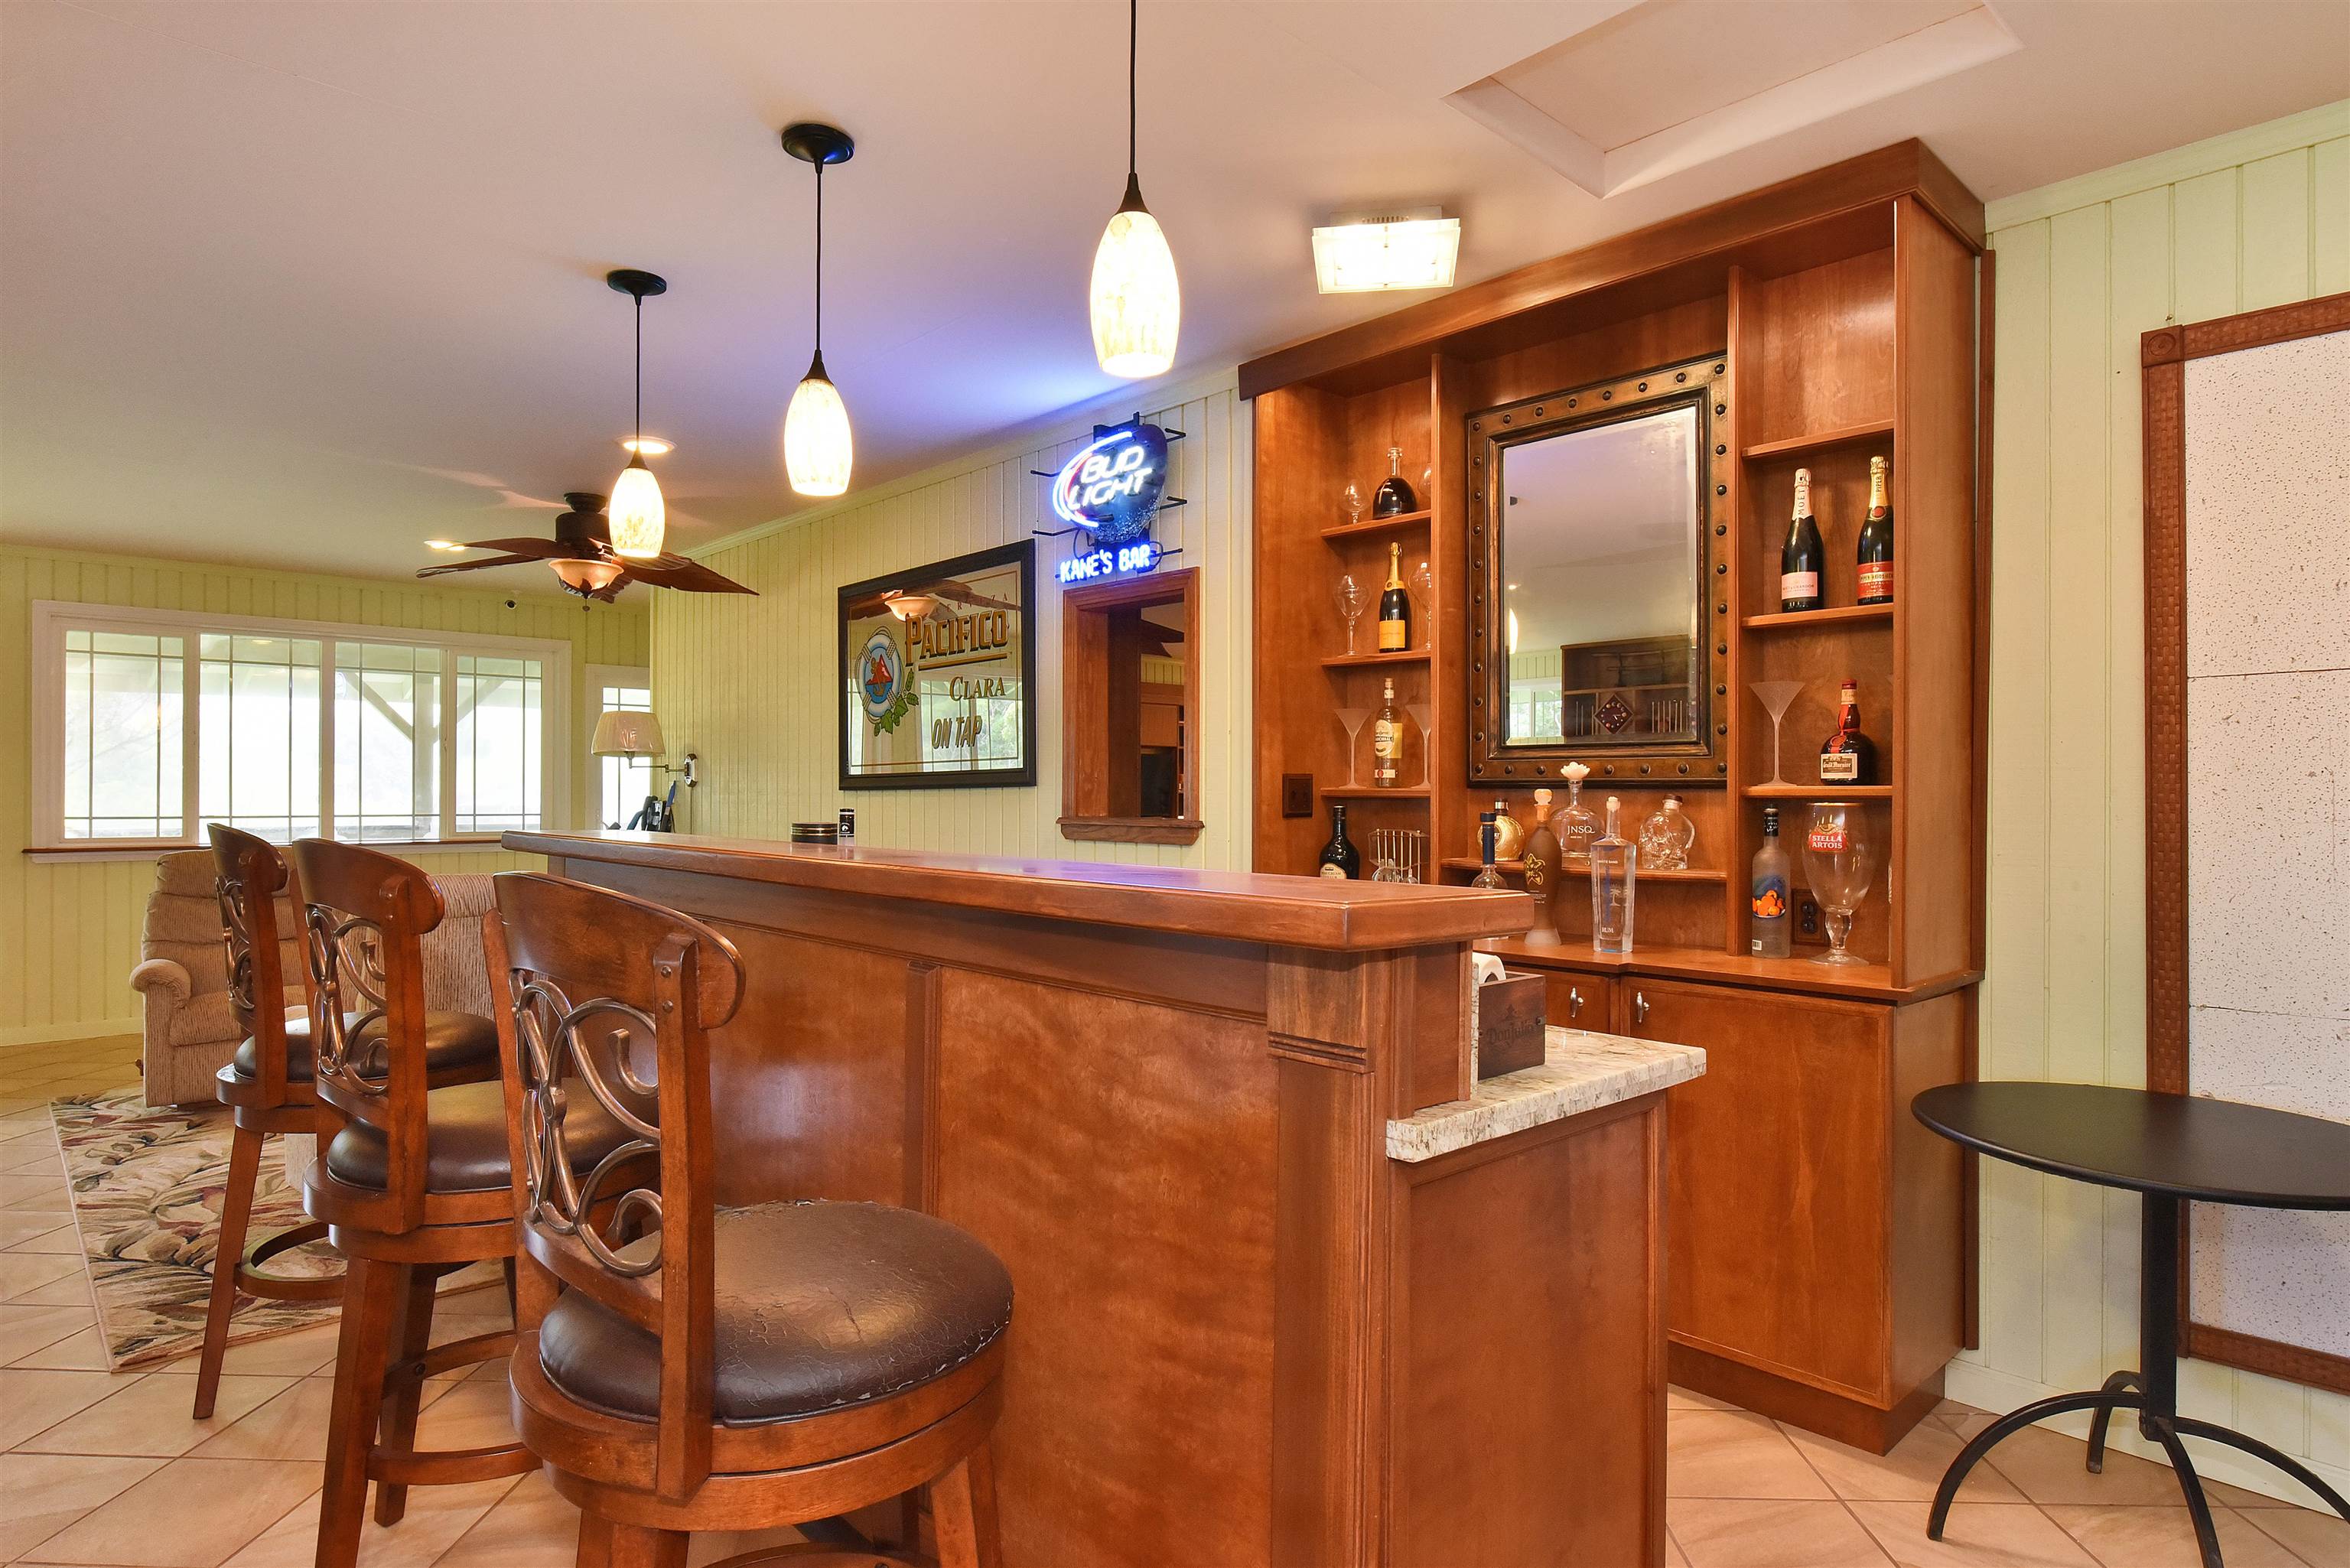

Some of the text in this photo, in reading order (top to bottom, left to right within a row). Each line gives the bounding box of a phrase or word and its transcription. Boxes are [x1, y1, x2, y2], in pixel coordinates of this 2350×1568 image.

[1080, 446, 1144, 483] BUD
[1067, 467, 1153, 511] LIGHT
[1059, 544, 1151, 583] KANE'S BAR
[905, 610, 1010, 667] PACIFICO
[949, 676, 1006, 701] CLARA
[932, 715, 983, 750] ON TAP
[1567, 825, 1596, 835] JNSQ
